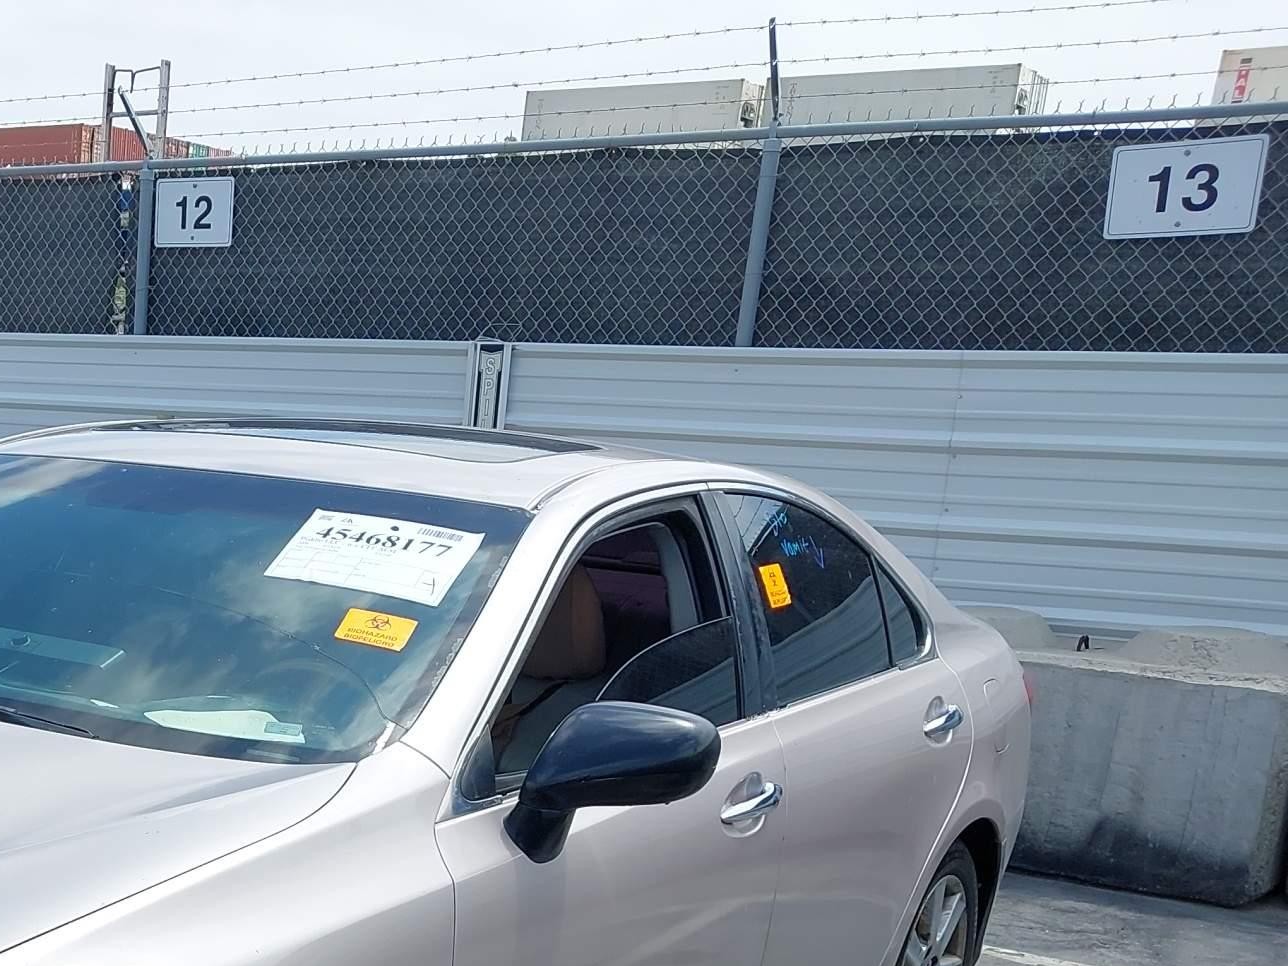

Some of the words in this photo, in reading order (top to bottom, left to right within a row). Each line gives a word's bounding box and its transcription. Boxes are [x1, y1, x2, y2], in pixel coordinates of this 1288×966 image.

[1148, 163, 1220, 213] 13
[175, 195, 213, 230] 12
[315, 526, 453, 557] 45468177
[347, 627, 398, 642] BIOHAZARD
